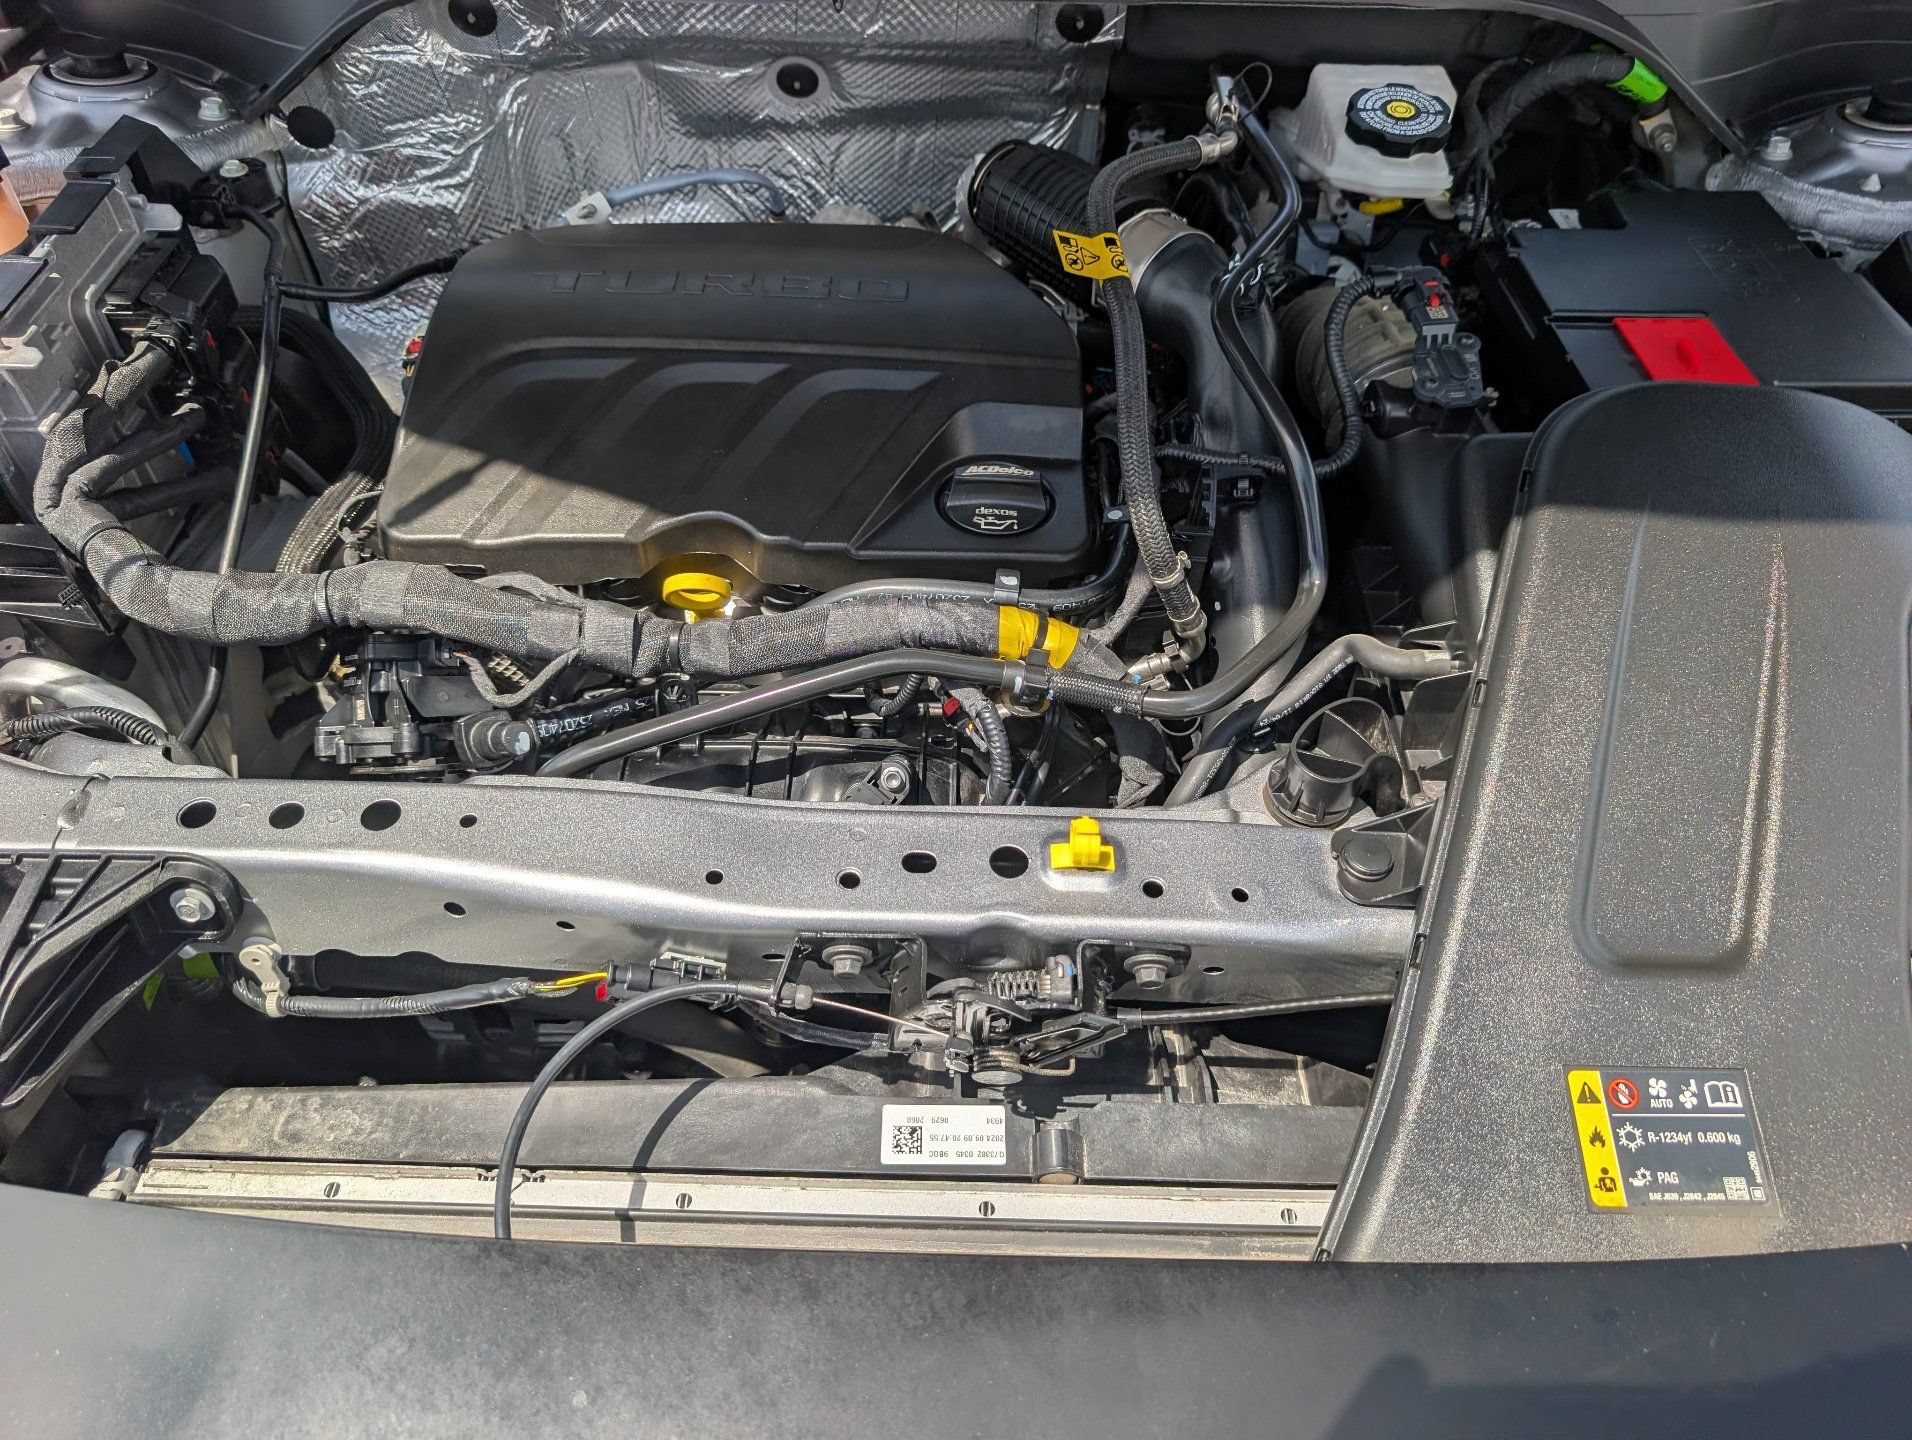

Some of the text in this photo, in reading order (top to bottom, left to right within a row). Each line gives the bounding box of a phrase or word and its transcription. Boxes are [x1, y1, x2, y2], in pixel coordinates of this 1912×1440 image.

[533, 269, 910, 302] TURBO
[961, 465, 1035, 477] ACDelco
[975, 506, 1018, 517] dexos
[1650, 1098, 1674, 1109] AUTO
[1647, 1131, 1741, 1146] R-1234yf 0.600 kg
[955, 1150, 974, 1158] 0345
[1656, 1171, 1680, 1185] PAG
